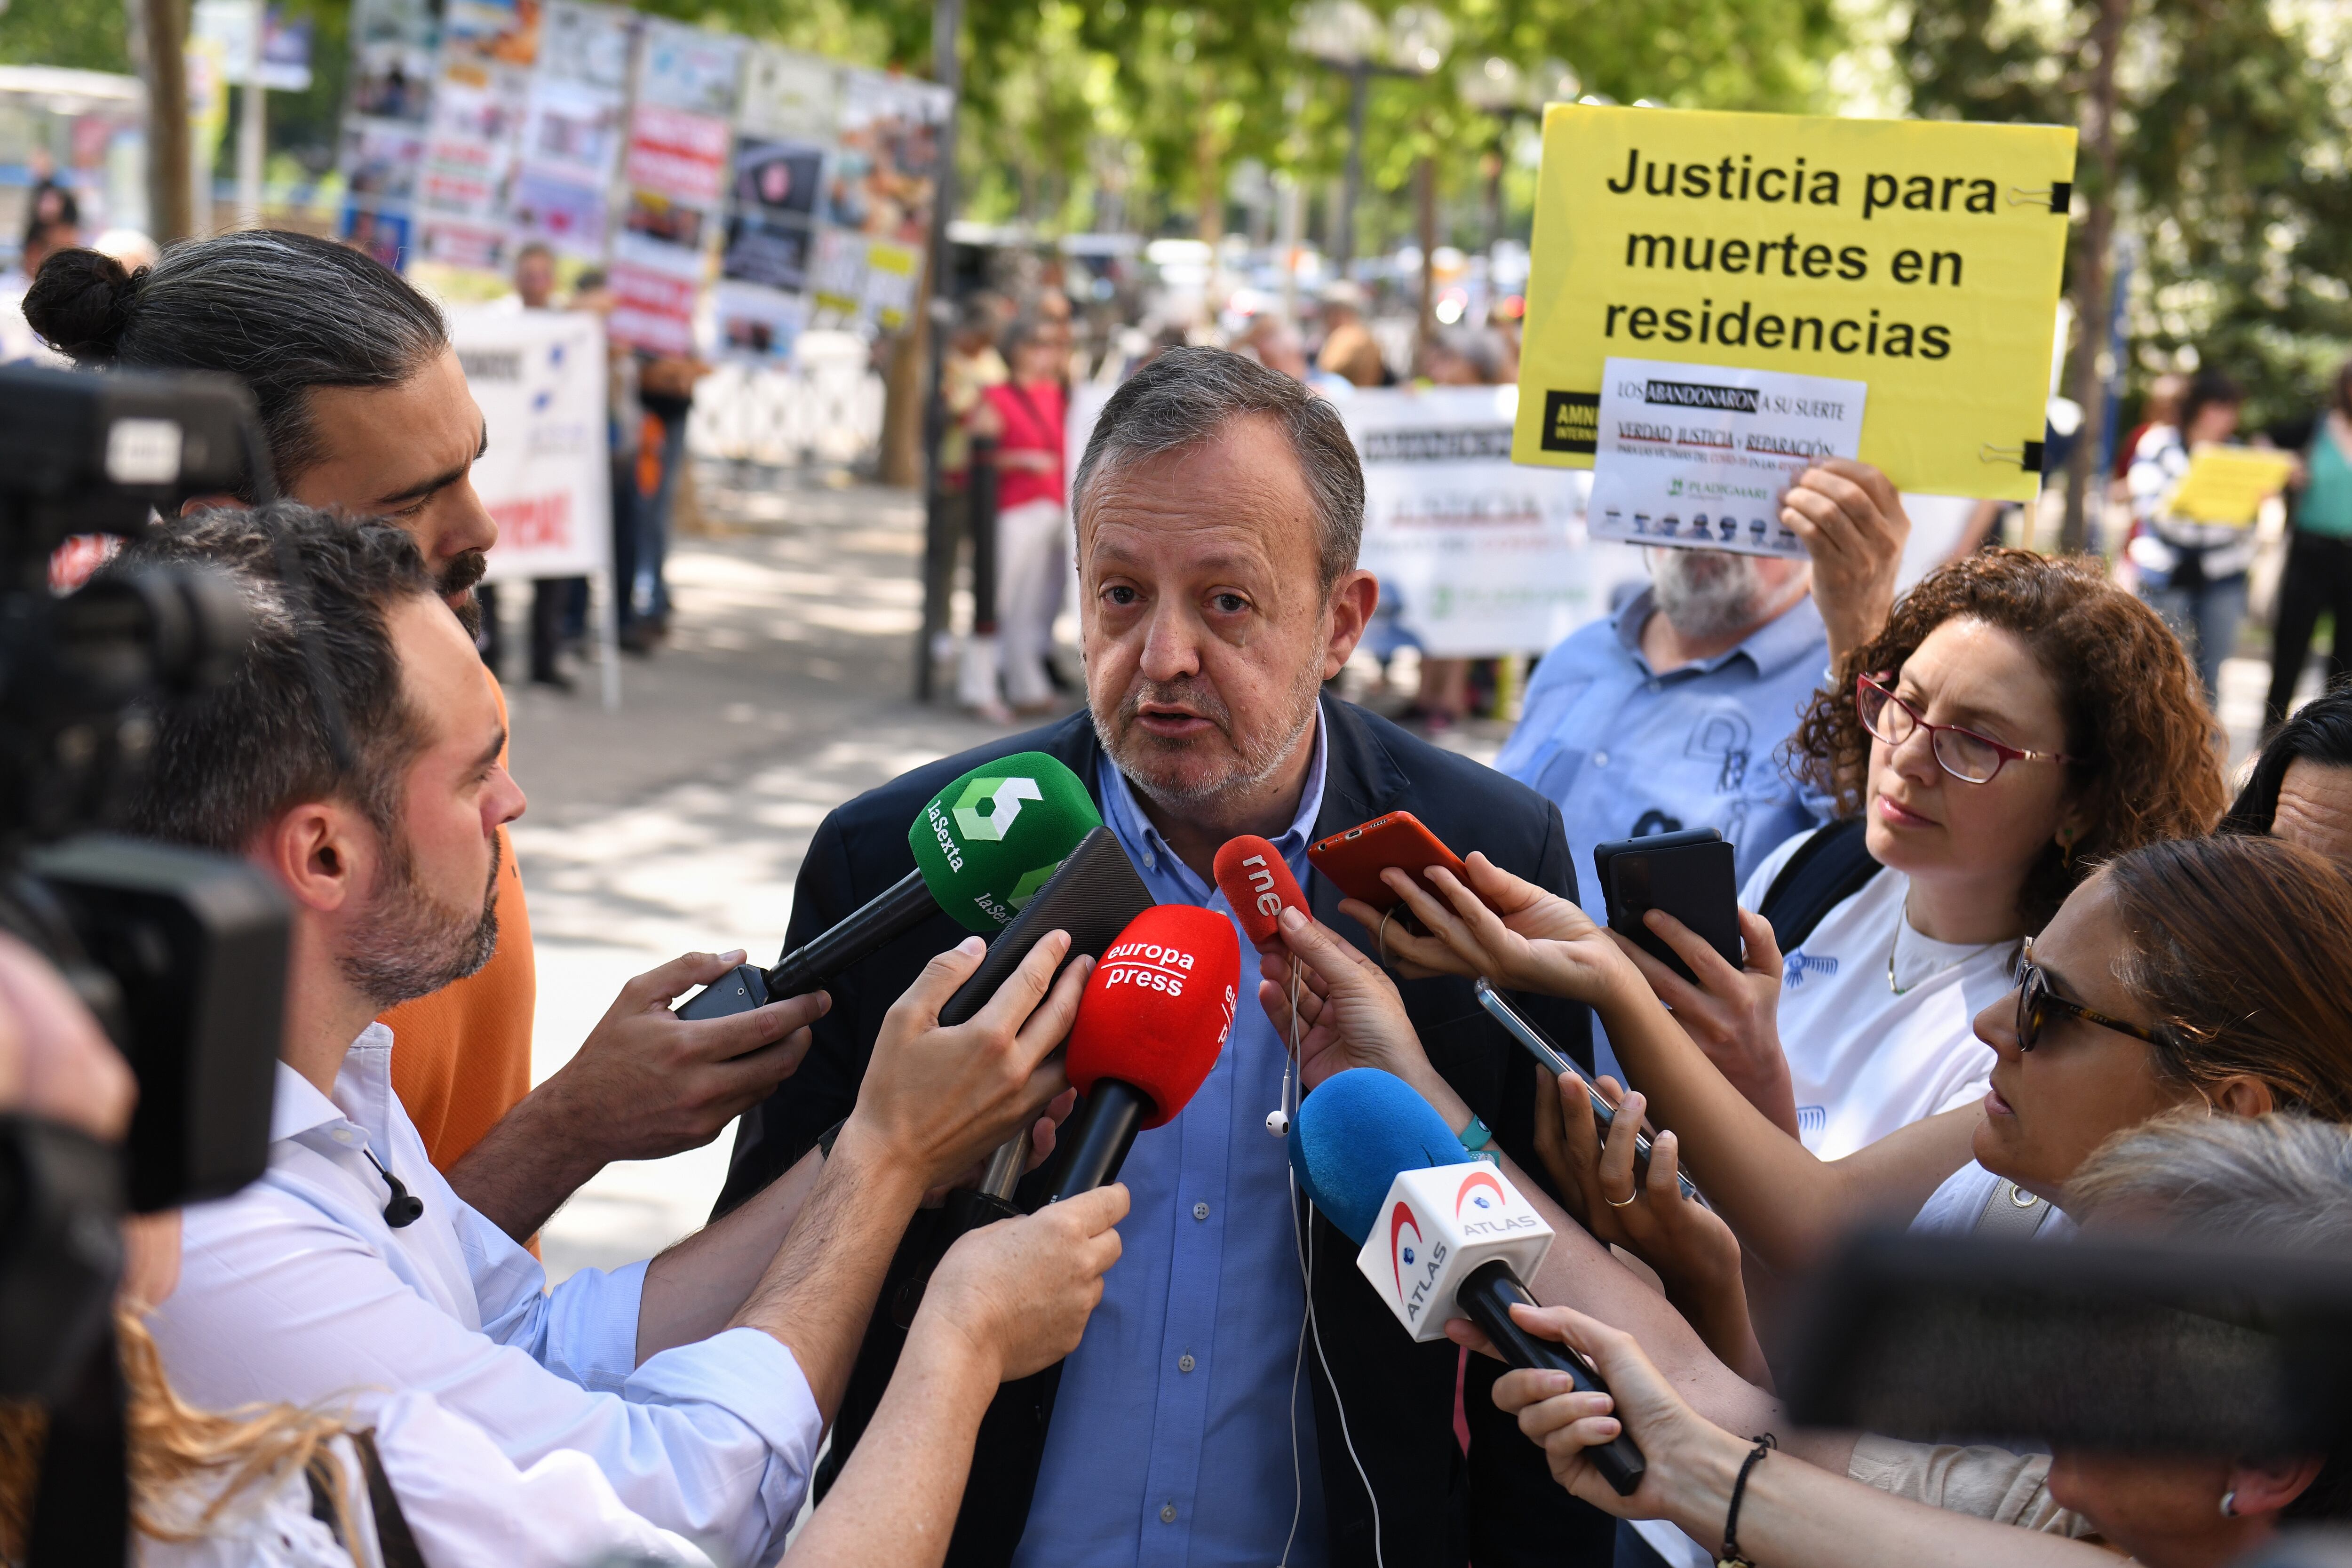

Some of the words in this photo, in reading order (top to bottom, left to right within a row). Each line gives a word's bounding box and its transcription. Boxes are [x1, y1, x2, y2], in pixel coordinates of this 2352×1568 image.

[1607, 149, 1840, 206] Justicia
[1863, 174, 1996, 219] para
[1626, 233, 1867, 281] muertes
[1891, 249, 1963, 287] en
[1605, 298, 1951, 360] residencias
[1618, 381, 1645, 399] LOS
[1647, 381, 1757, 411] ABANDONARON
[1761, 395, 1770, 409] A
[1775, 396, 1794, 415] SU
[1795, 399, 1845, 421] SUERTE
[1617, 421, 1672, 441] VERDAD
[1677, 427, 1733, 447] JUSTICIA
[1746, 431, 1834, 457] REPARACIÓN
[927, 799, 963, 873] laSexta
[1242, 854, 1282, 916] rne
[974, 892, 1014, 926] laSex
[1107, 943, 1195, 971] europa
[1105, 968, 1184, 997] press
[1464, 1215, 1538, 1236] ATLAS
[1406, 1241, 1447, 1322] ATLAS
